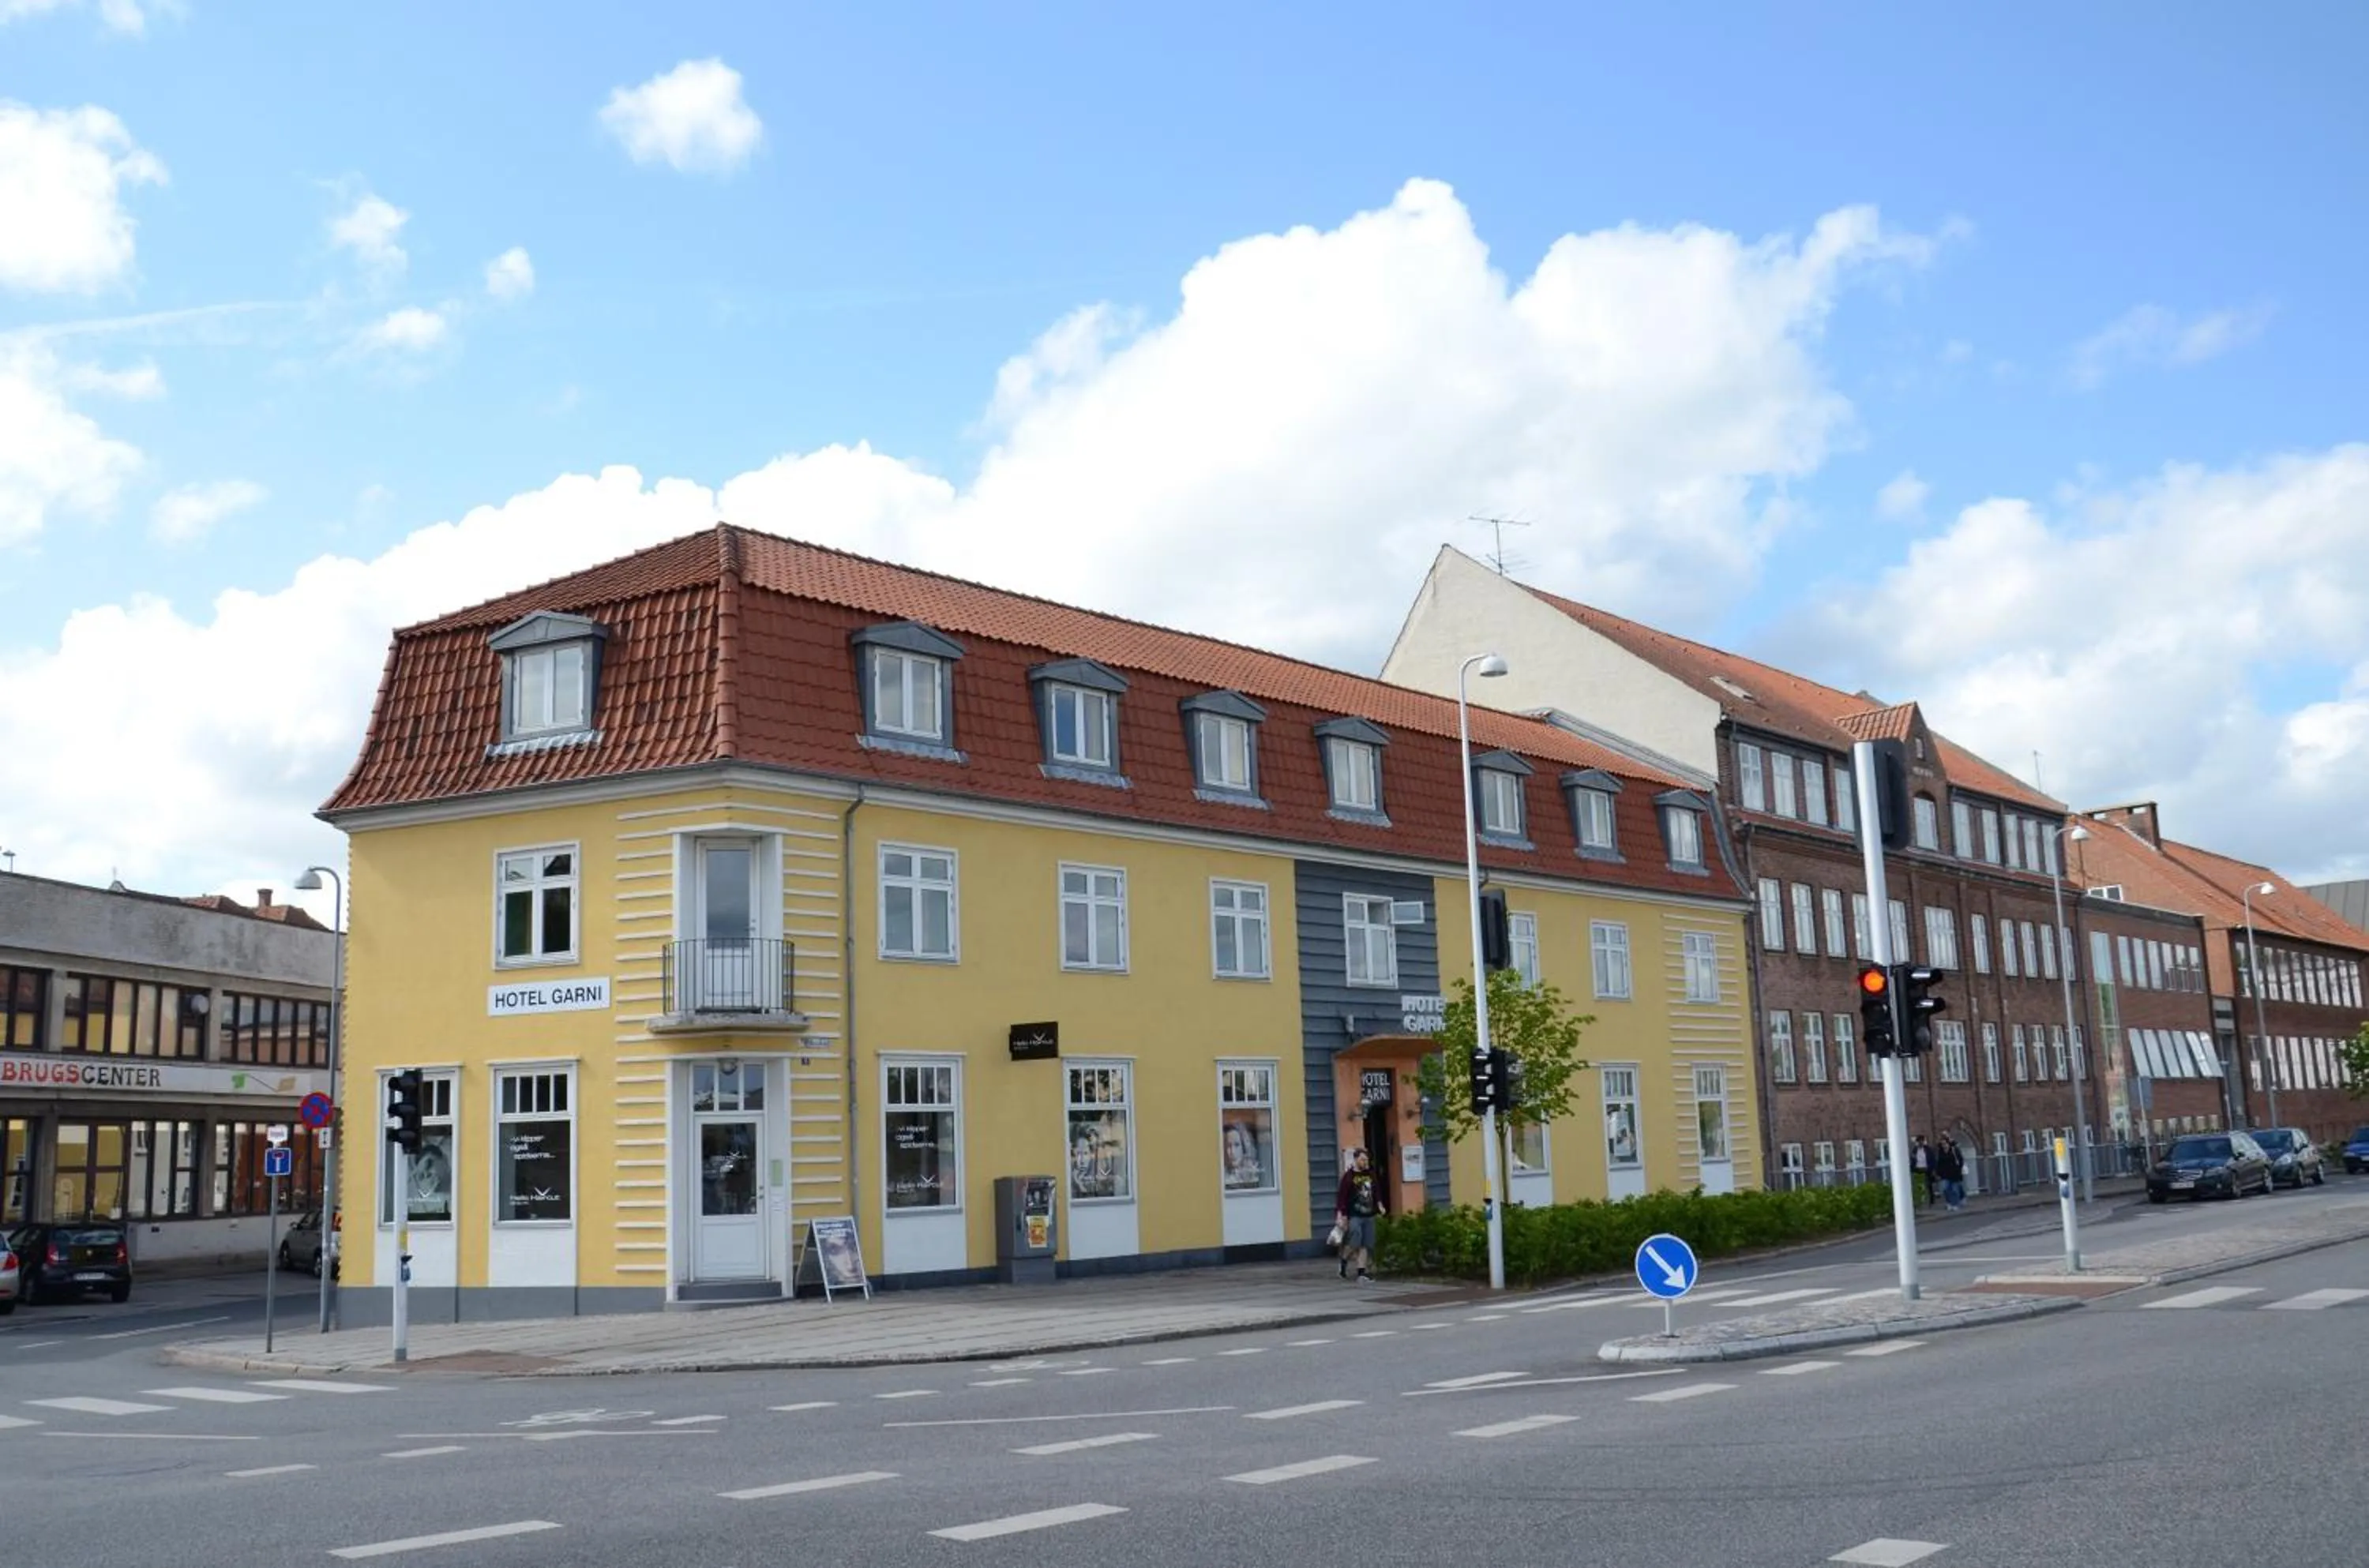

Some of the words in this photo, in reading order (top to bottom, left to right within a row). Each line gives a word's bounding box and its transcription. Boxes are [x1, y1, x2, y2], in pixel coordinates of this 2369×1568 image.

[495, 991, 546, 1008] HOTEL
[552, 985, 602, 1003] GARNI
[1404, 1015, 1446, 1032] GARN
[2, 1061, 161, 1086] BRUGSCENTER
